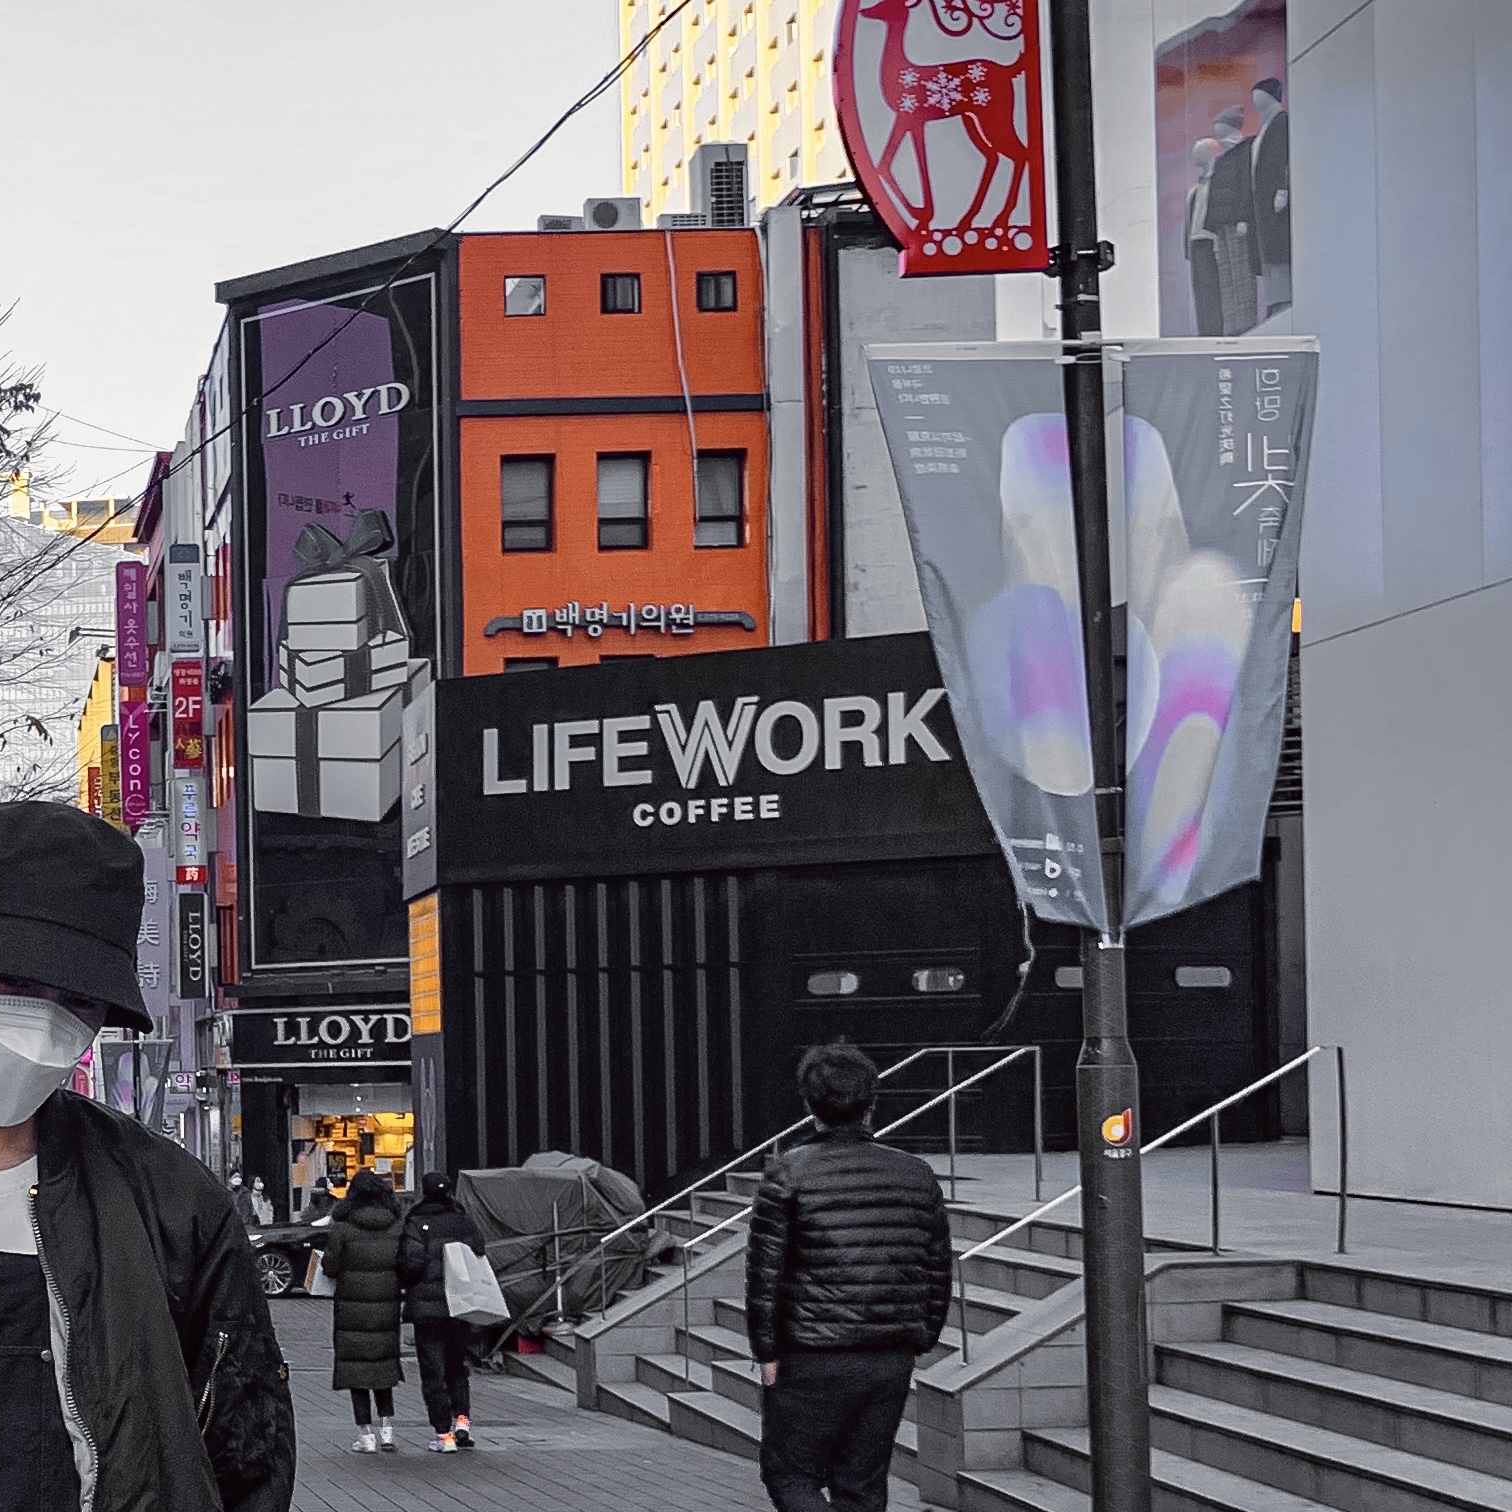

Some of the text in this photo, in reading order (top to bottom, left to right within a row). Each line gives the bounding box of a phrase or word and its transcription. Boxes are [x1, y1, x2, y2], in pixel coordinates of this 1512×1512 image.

[266, 382, 410, 438] LLOYD
[298, 423, 370, 447] THE GIFT
[554, 601, 695, 637] 백명기의원
[174, 696, 202, 717] 2F
[181, 784, 201, 860] 푸른약국
[632, 794, 781, 827] COFFEE
[188, 911, 202, 982] LLOYD
[273, 1013, 412, 1045] LLOYD
[310, 1047, 374, 1058] THE GIFT
